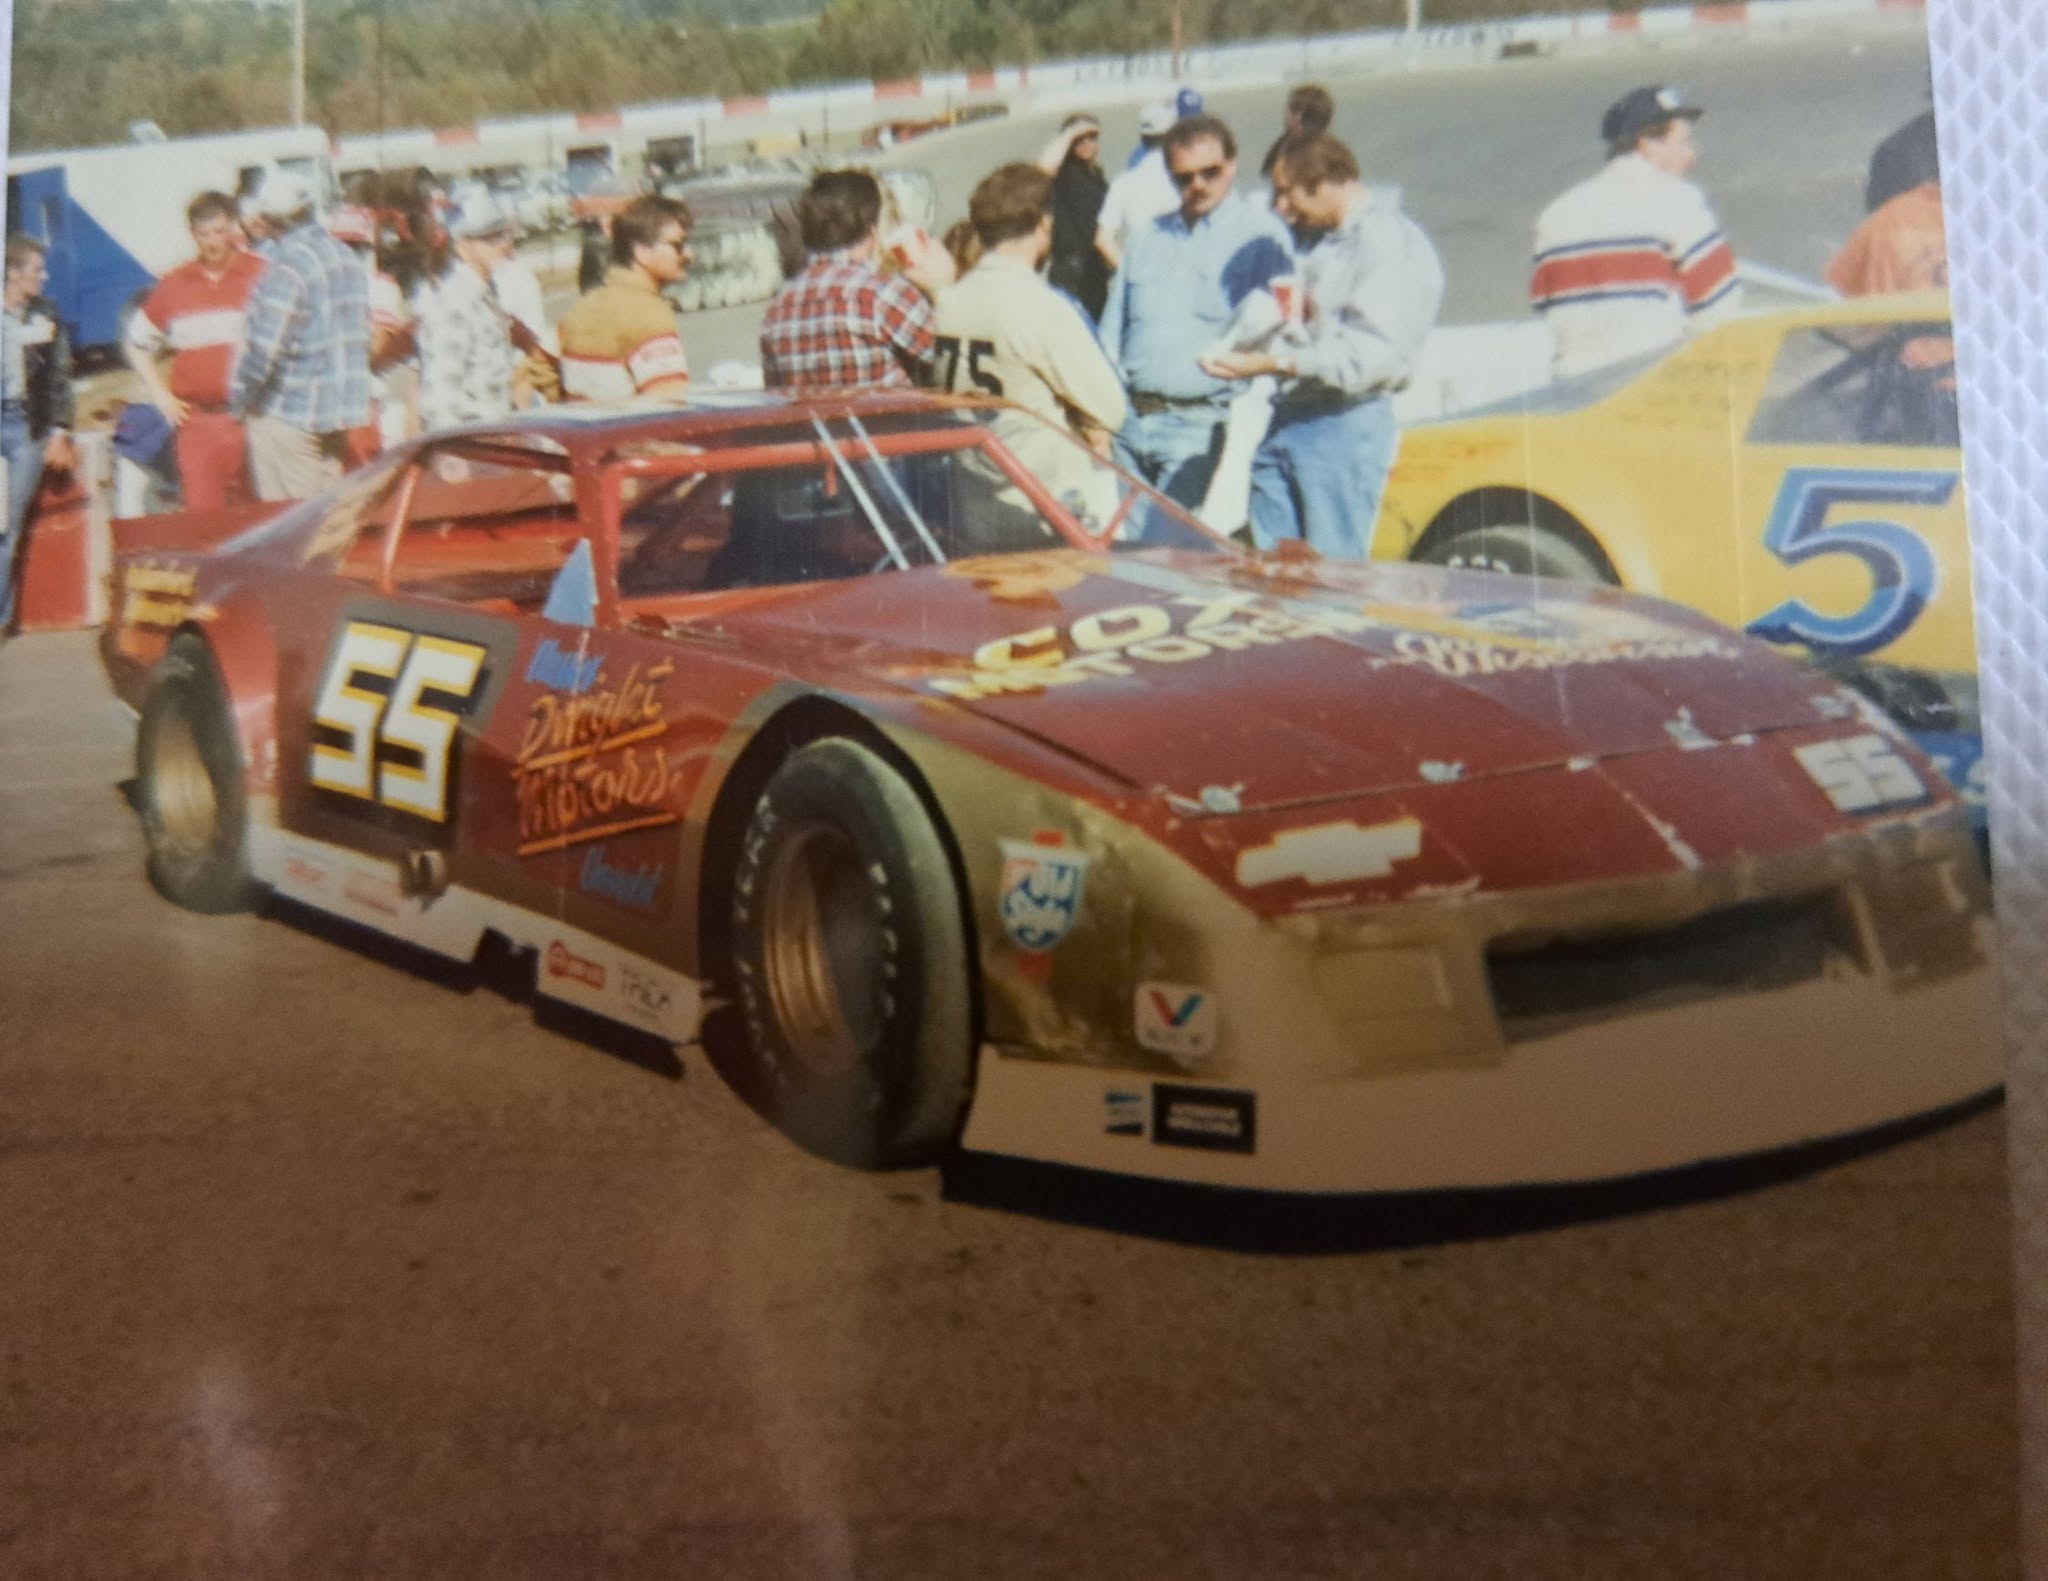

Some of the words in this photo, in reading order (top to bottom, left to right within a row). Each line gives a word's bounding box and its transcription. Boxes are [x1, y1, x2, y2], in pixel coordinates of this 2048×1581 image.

[934, 335, 1004, 396] 75
[1744, 467, 1960, 657] 5
[310, 620, 488, 824] 55
[1792, 733, 1927, 813] 55
